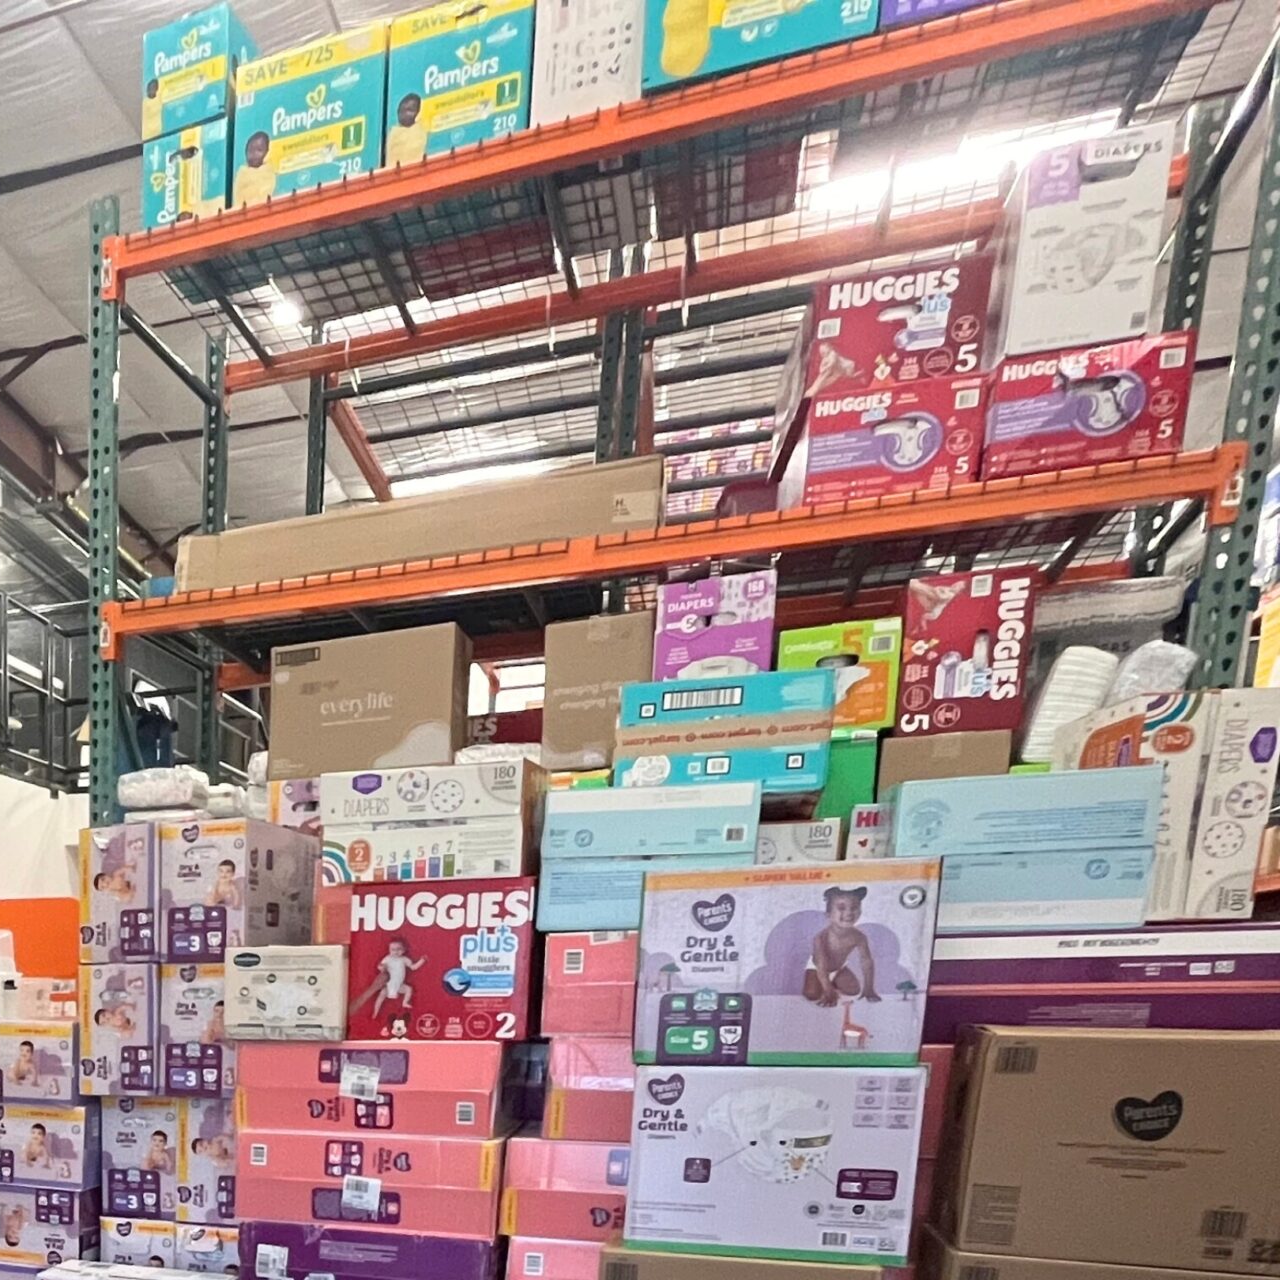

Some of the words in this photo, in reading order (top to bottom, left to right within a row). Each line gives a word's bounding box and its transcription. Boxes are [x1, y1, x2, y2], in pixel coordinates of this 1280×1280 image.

[411, 14, 447, 33] SAVE
[154, 41, 212, 76] Pampers
[244, 61, 288, 86] SAVE
[424, 56, 499, 93] Pampers
[272, 101, 343, 136] Pampers
[493, 113, 517, 131] 210
[339, 157, 362, 175] 210
[829, 267, 960, 310] HUGGIES
[954, 343, 979, 373] 5
[815, 392, 893, 418] HUGGIES
[1157, 419, 1174, 439] 5
[953, 456, 970, 476] 5
[667, 597, 715, 614] DIAPERS
[842, 628, 864, 654] 5
[991, 578, 1030, 701] HUGGIES
[900, 713, 930, 733] 5
[1217, 718, 1249, 775] DIAPERS
[493, 765, 517, 781] 180
[343, 797, 391, 819] DIAPERS
[808, 825, 833, 839] 180
[355, 849, 364, 861] 2
[445, 840, 453, 852] 7
[1229, 887, 1248, 912] 180
[350, 891, 530, 932] HUGGIES
[189, 935, 201, 952] 3
[463, 929, 516, 959] plus
[686, 935, 717, 950] Dry
[723, 935, 735, 947] &
[680, 949, 739, 963] Gentle
[495, 1012, 516, 1038] 2
[692, 1029, 709, 1050] 5
[185, 1070, 196, 1087] 3
[643, 1107, 670, 1121] Dry
[674, 1108, 685, 1119] &
[638, 1120, 688, 1132] Gentle
[127, 1195, 138, 1209] 3
